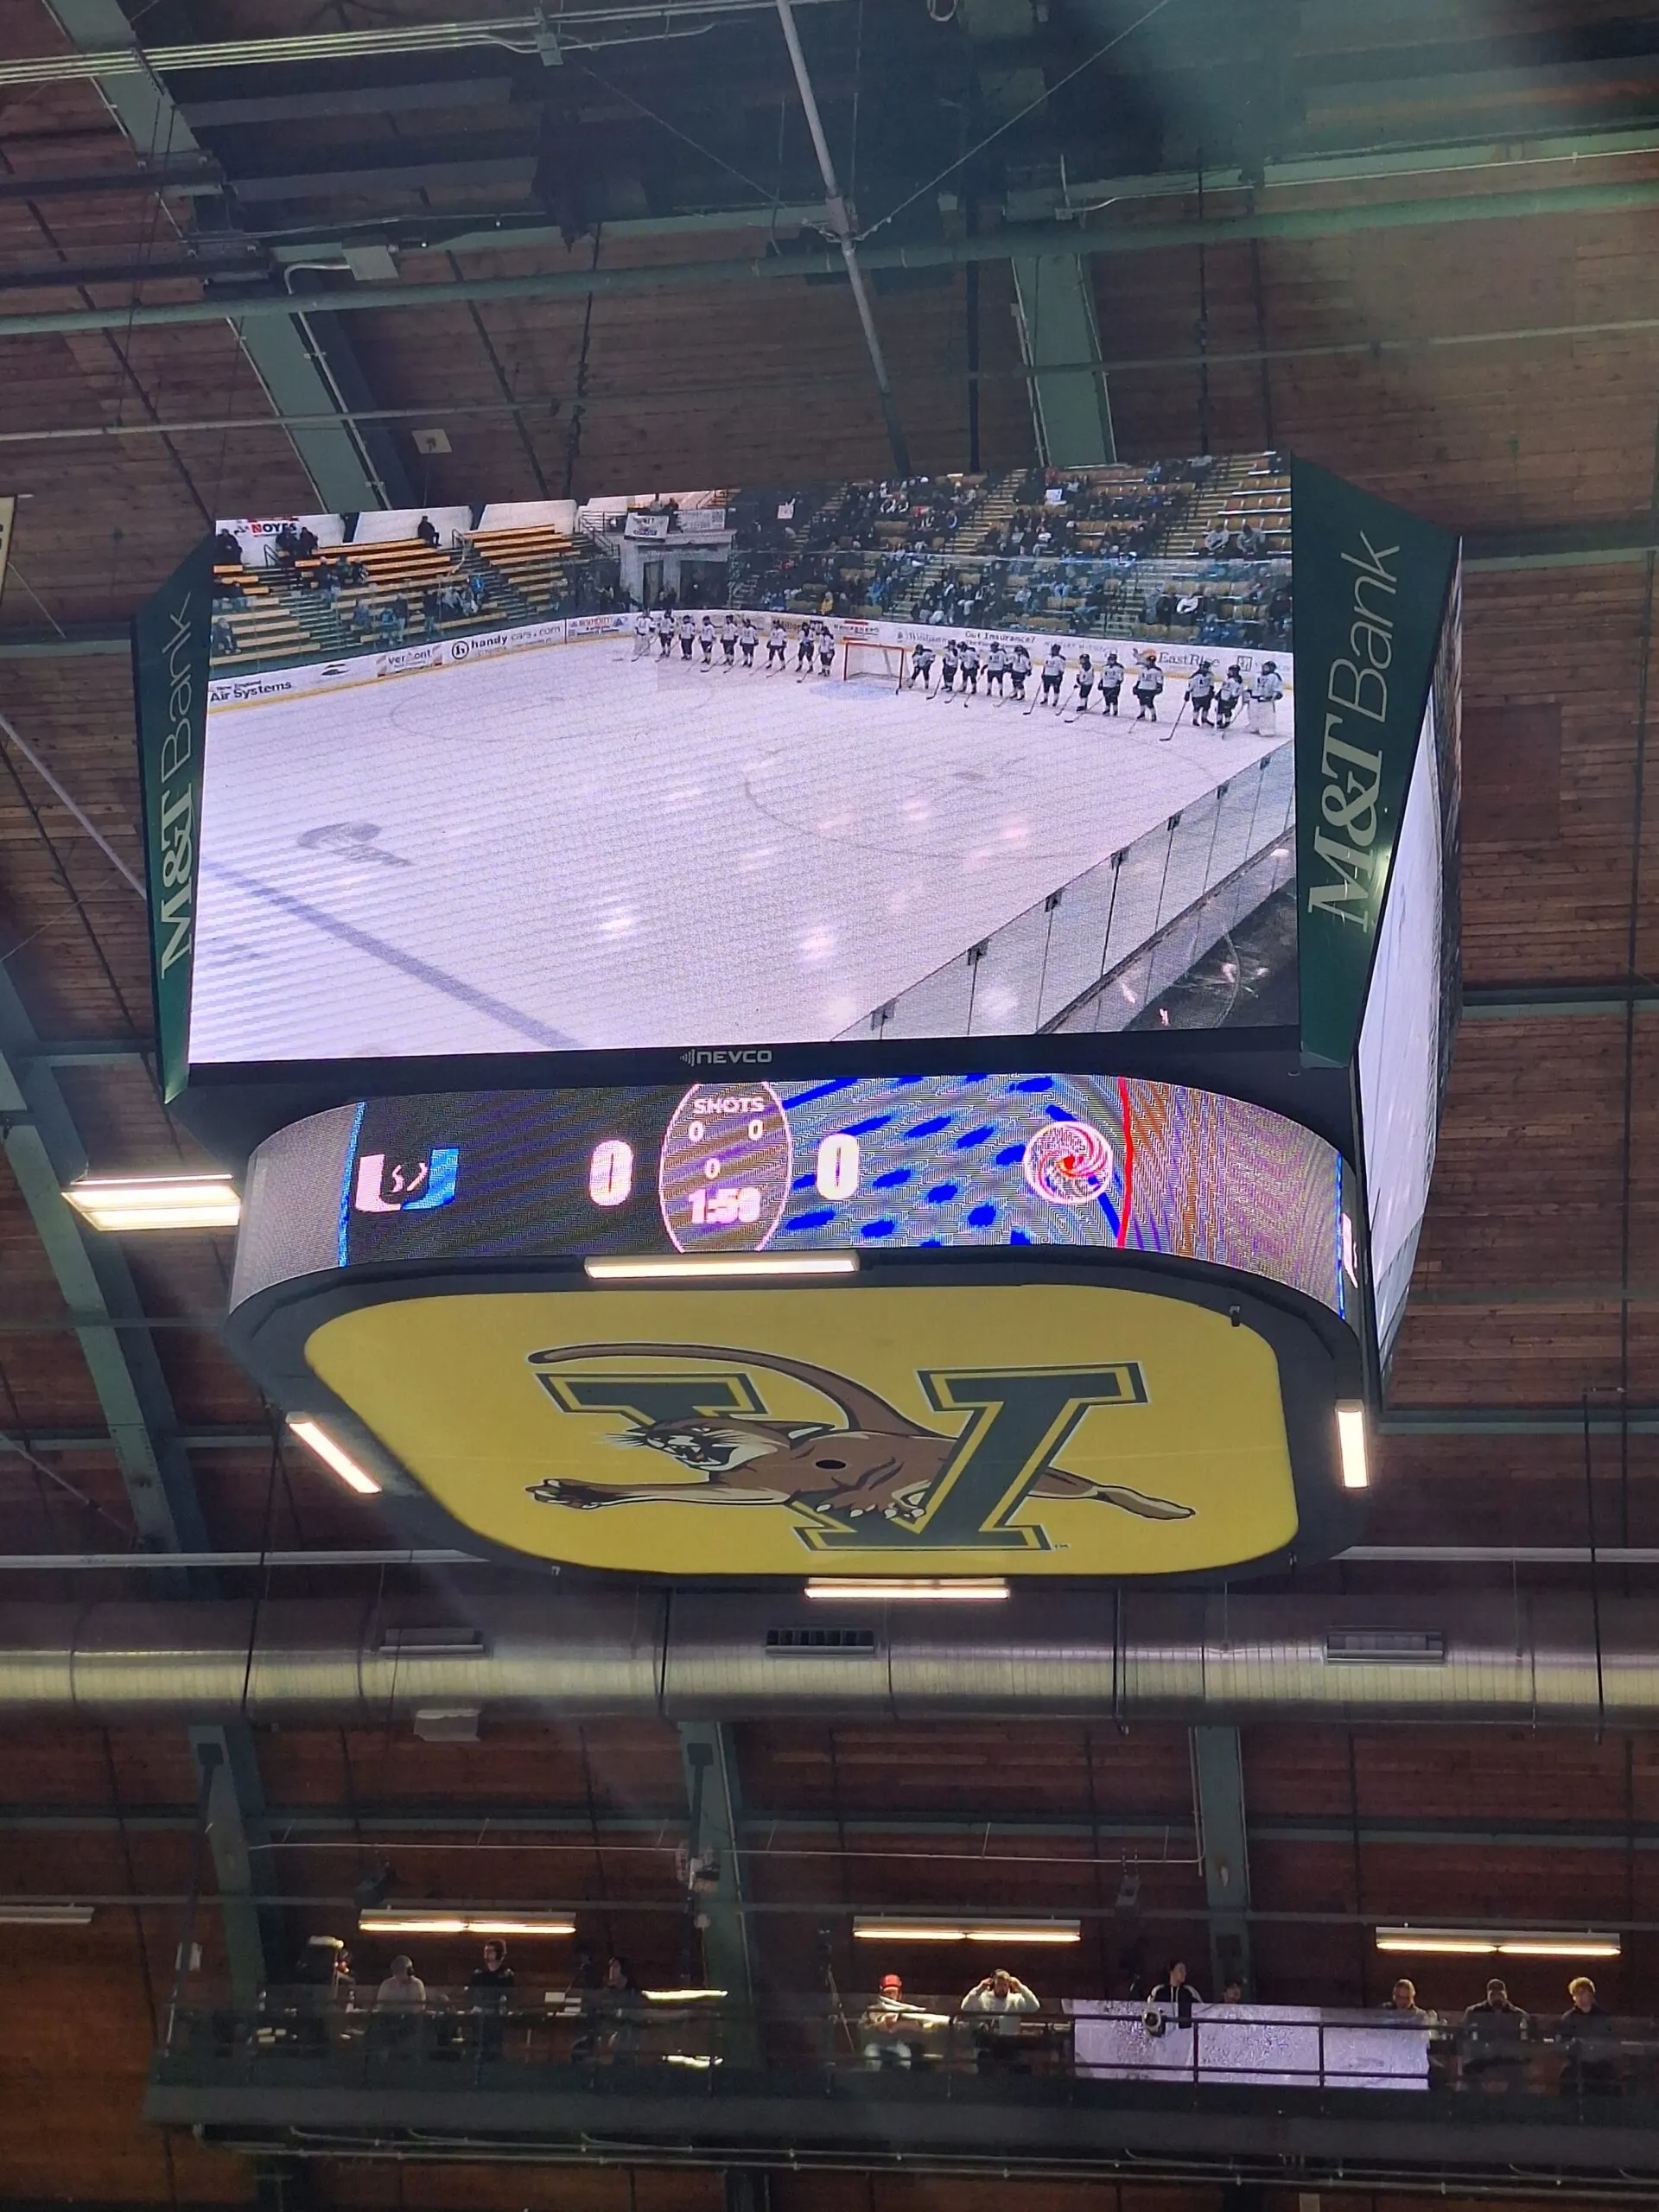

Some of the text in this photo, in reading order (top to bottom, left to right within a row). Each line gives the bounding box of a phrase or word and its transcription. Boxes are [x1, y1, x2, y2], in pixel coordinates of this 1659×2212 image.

[471, 635, 508, 649] handy
[210, 682, 292, 702] Air Systems
[1307, 531, 1400, 933] M&T Bank
[161, 592, 193, 980] M&T Bank
[696, 1050, 772, 1065] NEVCO
[693, 1096, 765, 1114] SHOTS
[689, 1119, 764, 1141] 0 0
[588, 1139, 633, 1206] 0
[816, 1133, 861, 1201] 0
